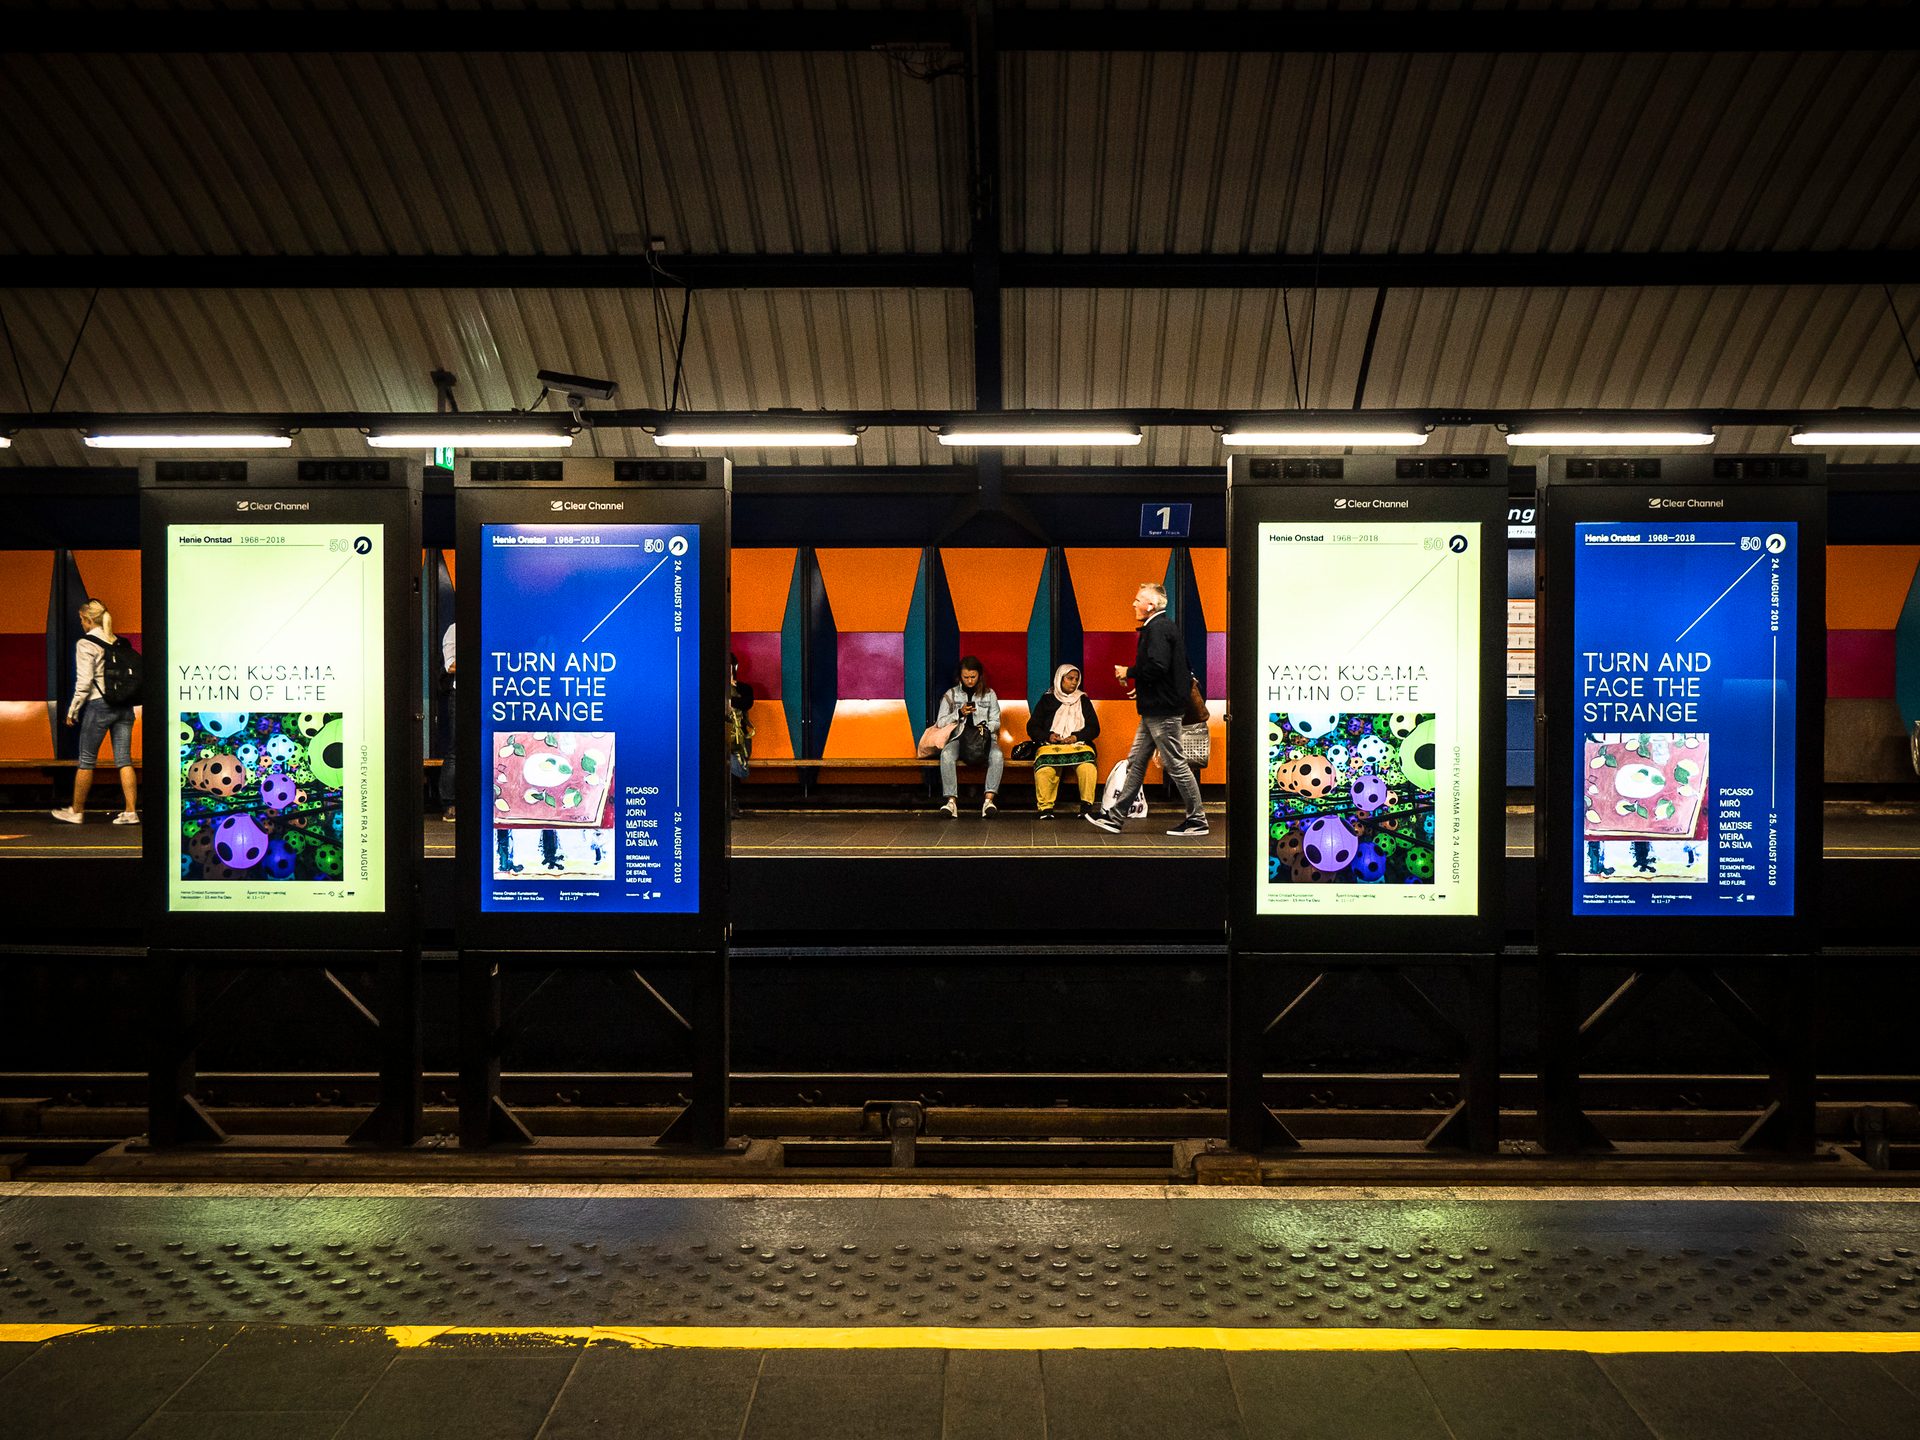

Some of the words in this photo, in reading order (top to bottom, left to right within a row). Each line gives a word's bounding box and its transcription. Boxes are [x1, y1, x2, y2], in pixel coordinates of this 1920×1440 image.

[250, 502, 272, 510] Clear
[274, 502, 309, 510] Channel
[564, 502, 587, 510] Clear
[588, 502, 624, 510] Channel
[1662, 499, 1685, 507] Clear
[1687, 499, 1723, 507] Channel
[1156, 507, 1170, 530] 1
[1508, 508, 1536, 523] ng
[329, 538, 348, 552] 50
[493, 536, 516, 544] Henie
[518, 536, 546, 544] Onstad
[1423, 538, 1444, 550] 50
[1585, 534, 1609, 542] Henie
[1610, 534, 1640, 542] Onstad
[1740, 536, 1761, 550] 50
[644, 539, 664, 553] 50
[674, 560, 682, 574] 24.
[1771, 558, 1779, 572] 24.
[674, 576, 682, 609] AUGUST
[1771, 574, 1779, 608] AUGUST
[674, 611, 682, 632] 2018
[1770, 610, 1778, 631] 2018
[491, 652, 556, 672] TURN
[565, 652, 616, 672] AND
[1583, 652, 1648, 672] TURN
[1658, 652, 1711, 672] AND
[179, 665, 237, 680] YAYOI
[247, 665, 335, 680] KUSAMA
[1268, 665, 1327, 680] YAYOI
[1338, 665, 1428, 680] KUSAMA
[179, 686, 240, 701] HYMN
[250, 686, 274, 701] OF
[285, 686, 326, 701] LIFE
[492, 677, 551, 697] FACE
[560, 677, 606, 697] THE
[1268, 686, 1329, 701] HYMN
[1340, 686, 1366, 701] OF
[1376, 686, 1418, 701] LIFE
[1584, 677, 1644, 697] FACE
[1653, 677, 1700, 697] THE
[492, 701, 604, 722] STRANGE
[1584, 702, 1698, 722] STRANGE
[626, 820, 658, 828] MATISSE
[1720, 822, 1752, 830] MATISSE
